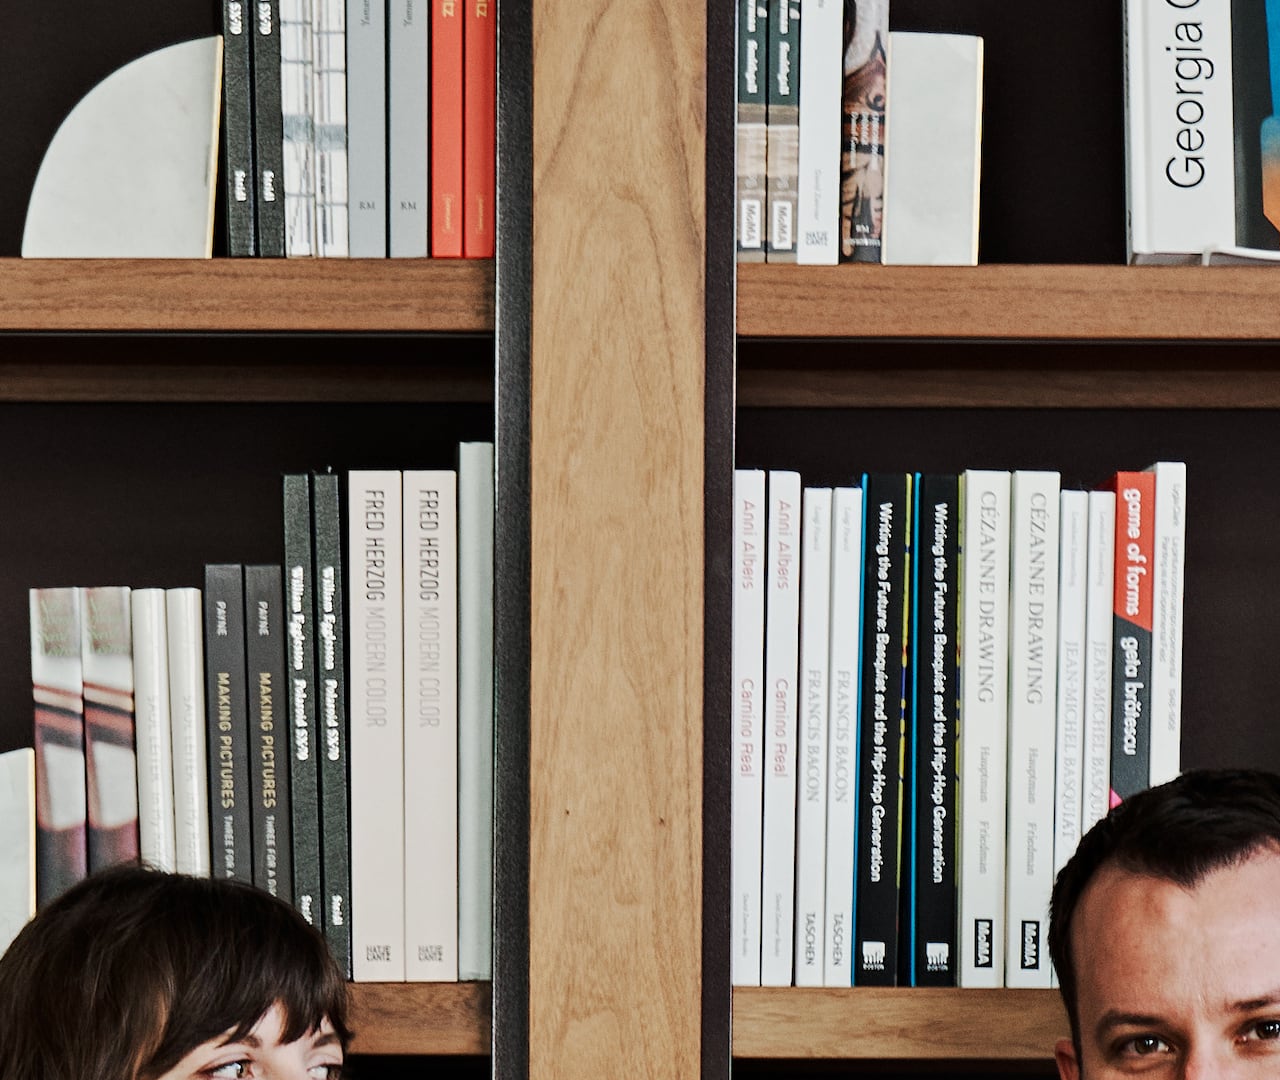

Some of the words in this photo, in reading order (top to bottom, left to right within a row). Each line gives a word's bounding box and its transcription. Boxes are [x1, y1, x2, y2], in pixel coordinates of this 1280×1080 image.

[1165, 21, 1214, 189] Georgia
[745, 203, 757, 243] MoMA
[776, 205, 788, 244] MoMA
[365, 489, 385, 532] FRED
[419, 489, 440, 532] FRED
[742, 499, 756, 536] Anni
[777, 499, 792, 536] Anni
[876, 502, 893, 556] Writing
[931, 502, 948, 556] Writing
[1123, 488, 1143, 539] game
[742, 541, 756, 589] Albers
[776, 541, 792, 589] Albers
[979, 490, 1000, 593] CÉZANNE
[1028, 491, 1049, 595] CÉZANNE
[1126, 543, 1146, 564] of
[290, 566, 305, 613] William
[321, 566, 335, 613] William
[365, 537, 386, 601] HERZOG
[419, 537, 440, 601] HERZOG
[877, 556, 891, 581] the
[933, 556, 948, 581] the
[1126, 565, 1146, 616] forms
[216, 600, 228, 637] PAYNE
[258, 600, 270, 637] PAYNE
[876, 581, 891, 632] Future:
[932, 582, 948, 633] Future:
[289, 613, 305, 671] Eggleston
[320, 613, 336, 671] Eggleston
[366, 606, 387, 672] MODERN
[420, 606, 441, 672] MODERN
[873, 633, 890, 692] Basquiat
[931, 634, 948, 693] Basquiat
[978, 600, 996, 703] DRAWING
[1026, 601, 1045, 705] DRAWING
[1120, 637, 1141, 677] geta
[217, 672, 232, 732] MAKING
[259, 672, 274, 732] MAKING
[294, 679, 308, 728] Polaroid
[324, 679, 338, 728] Polaroid
[366, 678, 387, 729] COLOR
[420, 678, 441, 729] COLOR
[740, 677, 755, 738] Camino
[774, 677, 790, 738] Camino
[807, 669, 822, 740] FRANCIS
[835, 669, 851, 741] FRANCIS
[874, 693, 888, 721] and
[933, 694, 947, 722] and
[1064, 641, 1079, 752] JEAN-MICHEL
[295, 728, 310, 761] SX-70
[326, 728, 340, 761] SX-70
[874, 721, 887, 745] the
[933, 722, 947, 746] the
[219, 735, 234, 810] PICTURES
[261, 735, 277, 810] PICTURES
[740, 743, 755, 777] Real
[774, 743, 788, 777] Real
[806, 745, 821, 802] BACON
[834, 745, 849, 803] BACON
[870, 746, 887, 804] Hip-Hop
[930, 747, 947, 805] Hip-Hop
[1061, 756, 1077, 840] BASQUIAT
[871, 805, 886, 882] Generation
[932, 806, 947, 884] Generation
[805, 911, 816, 966] TASCHEN
[832, 912, 843, 967] TASCHEN
[977, 921, 990, 965] MoMA
[1024, 922, 1037, 967] MoMA
